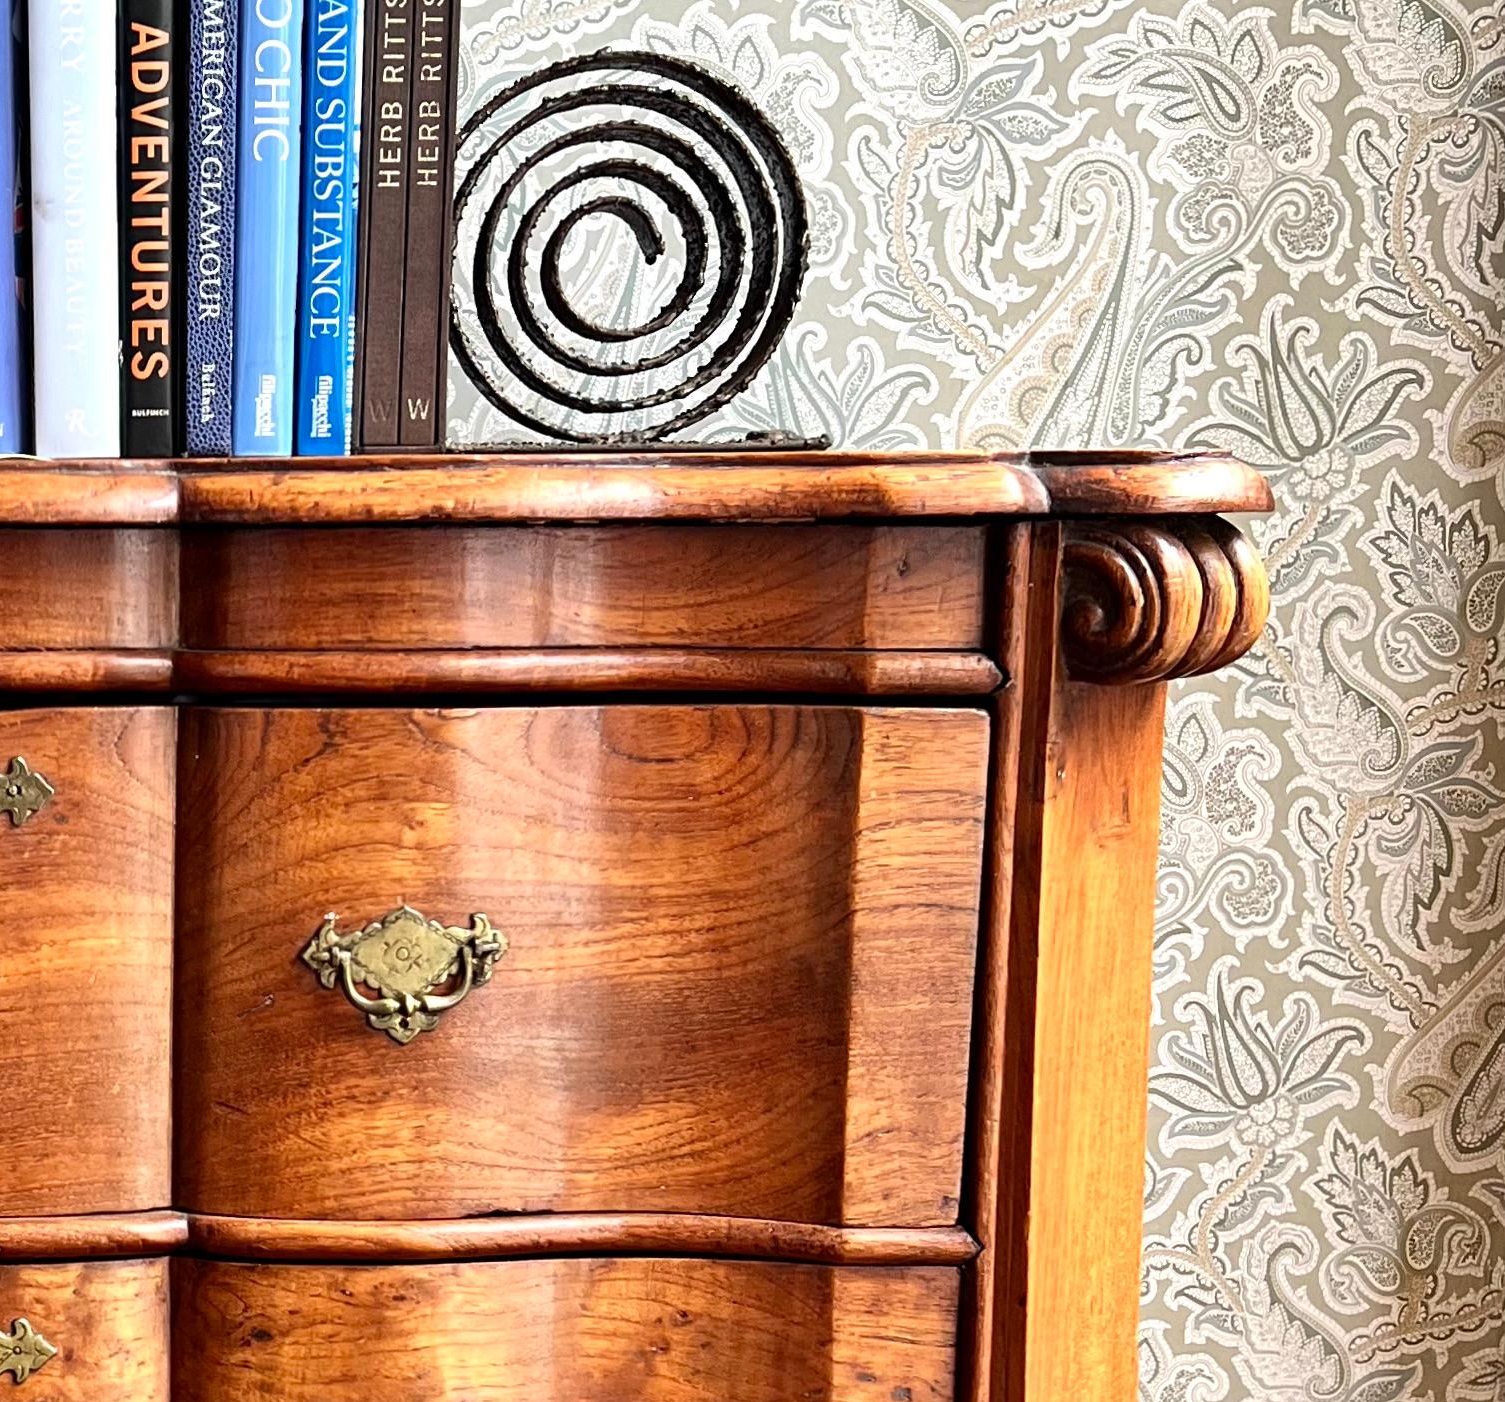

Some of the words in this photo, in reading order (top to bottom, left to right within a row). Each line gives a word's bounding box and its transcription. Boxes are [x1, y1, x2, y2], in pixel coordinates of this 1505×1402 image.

[317, 0, 349, 87] AND
[253, 39, 292, 161] CHIC
[378, 101, 403, 187] HERB
[416, 101, 441, 186] HERB
[62, 96, 83, 228] AROUND
[131, 22, 170, 380] ADVENTURES
[198, 156, 223, 320] GLAMOUR
[309, 98, 346, 339] SUBSTANCE
[64, 238, 85, 354] BEAUTY
[132, 409, 170, 417] BULFINCH
[200, 361, 215, 424] Bulfinch
[407, 398, 430, 420] W
